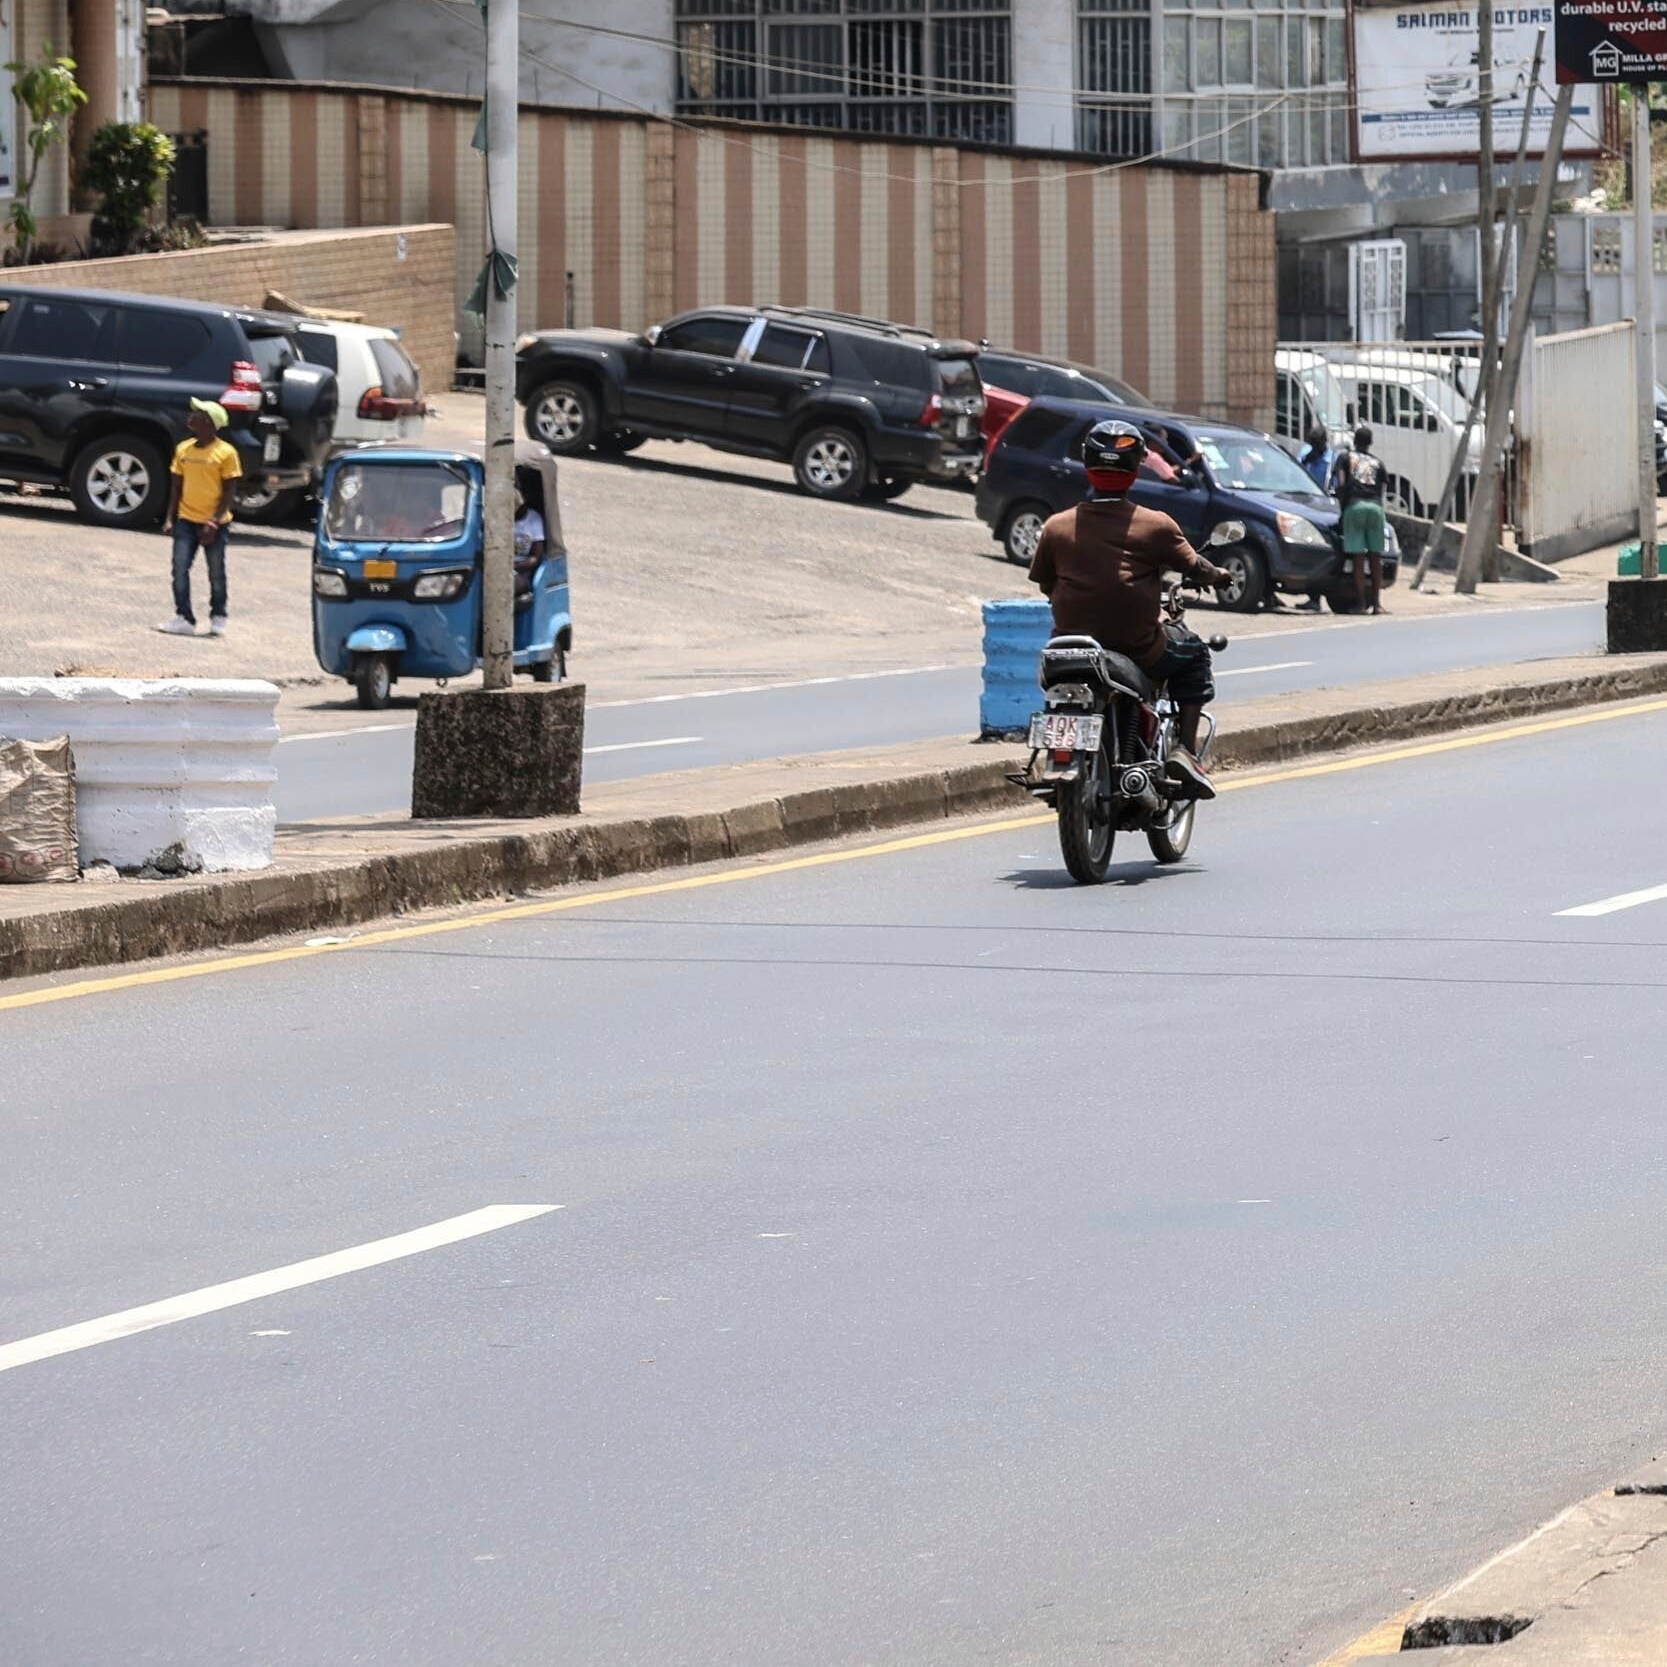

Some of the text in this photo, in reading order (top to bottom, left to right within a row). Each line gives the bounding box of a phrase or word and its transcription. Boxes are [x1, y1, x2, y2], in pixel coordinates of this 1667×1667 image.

[1561, 2, 1614, 15] durable
[1617, 1, 1644, 13] U.V.
[1609, 17, 1666, 34] recycled
[1596, 57, 1617, 69] MG
[1622, 53, 1652, 63] MILLA
